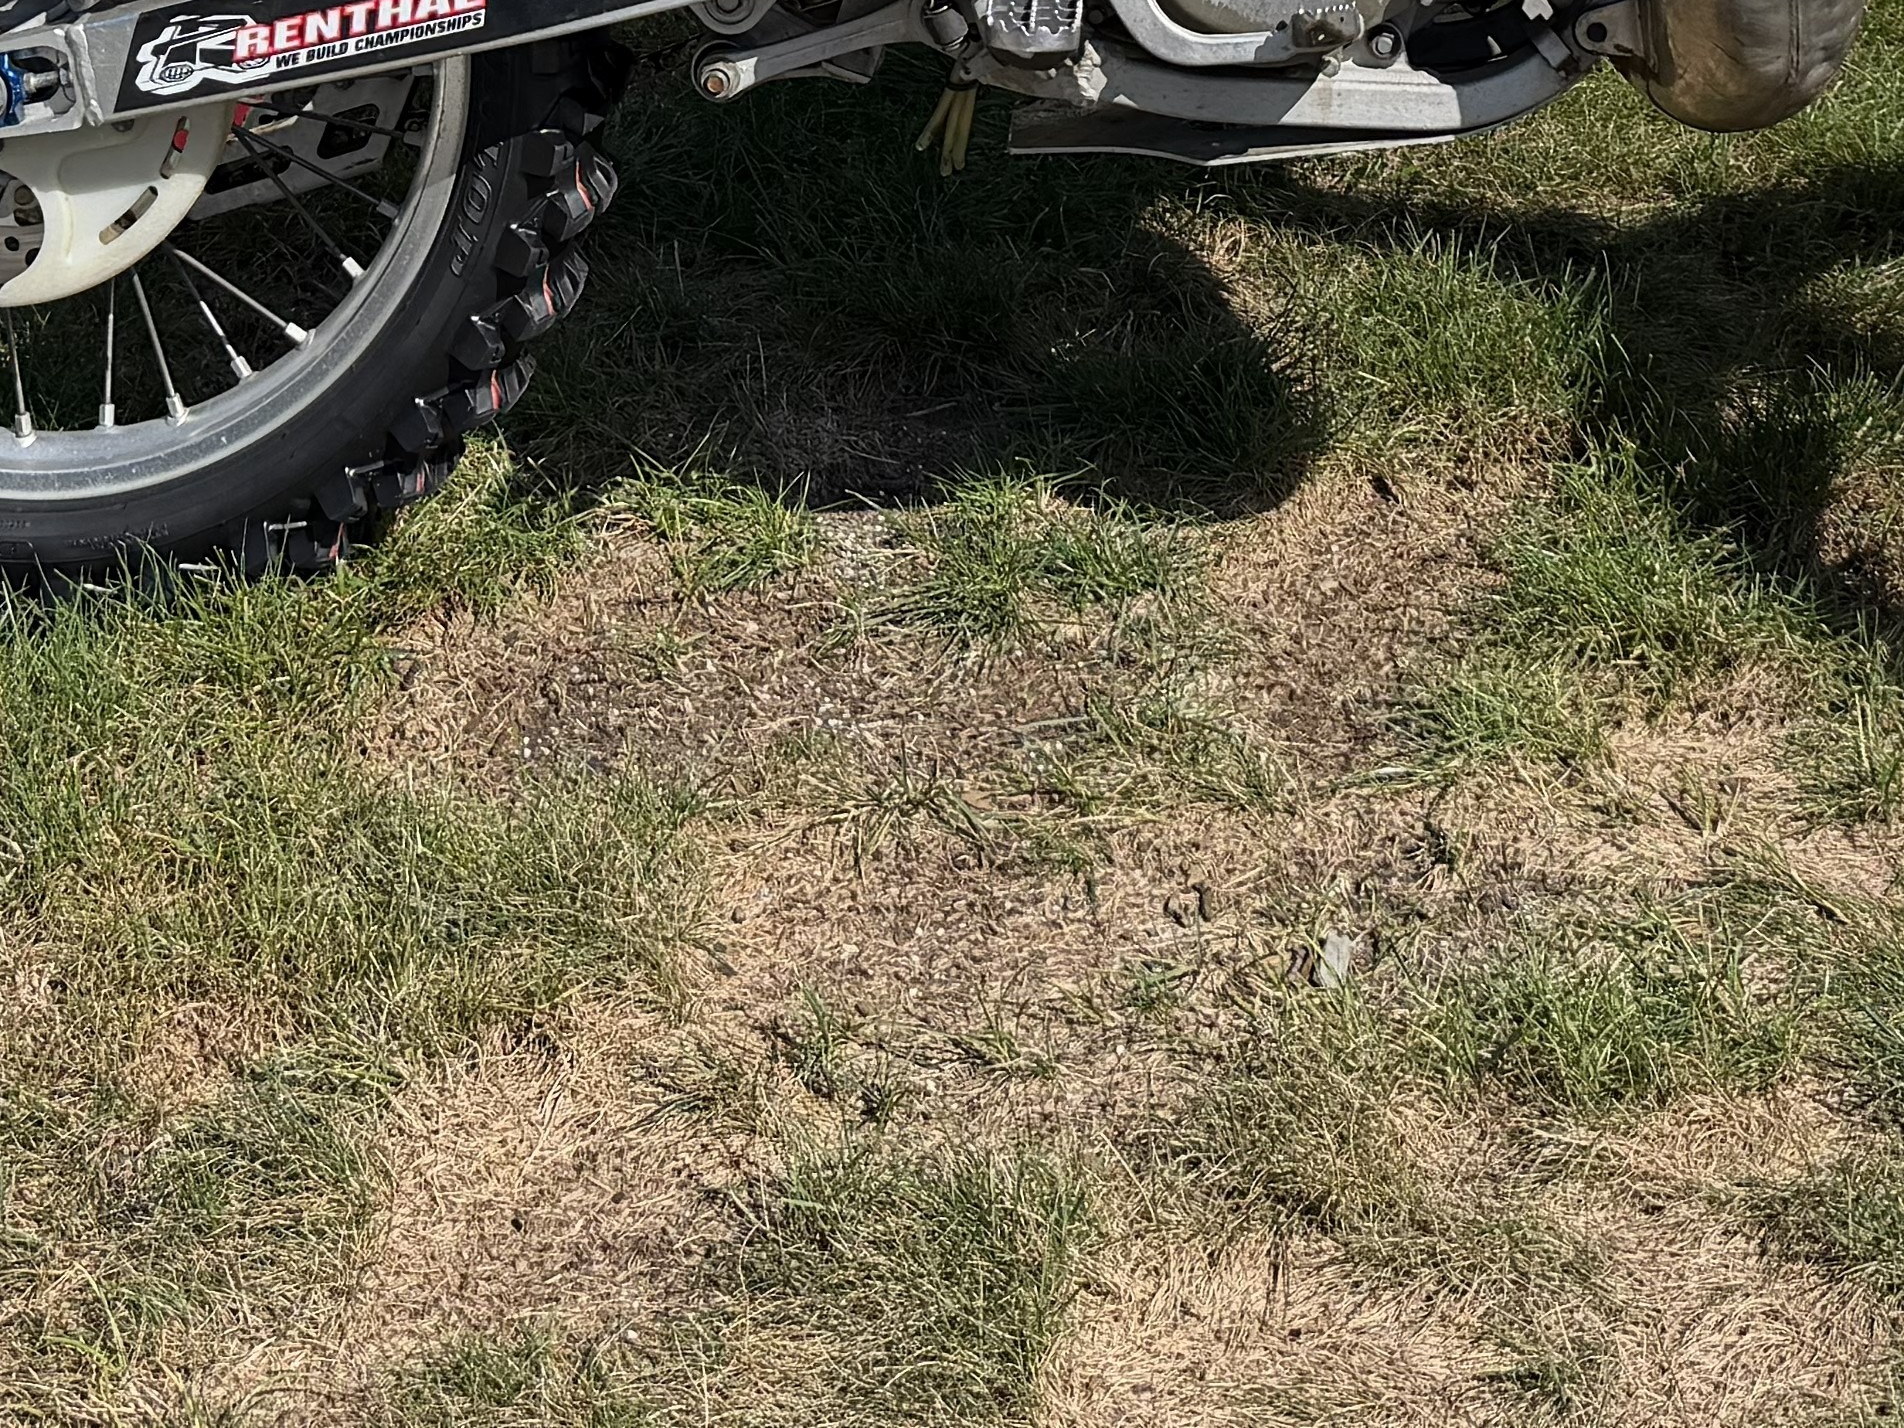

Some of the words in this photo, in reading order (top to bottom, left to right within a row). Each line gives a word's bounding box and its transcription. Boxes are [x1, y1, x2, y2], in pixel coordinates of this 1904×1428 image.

[276, 53, 300, 68] WE
[306, 43, 349, 61] BUILD
[354, 12, 483, 52] CHAMPIONSHIPS
